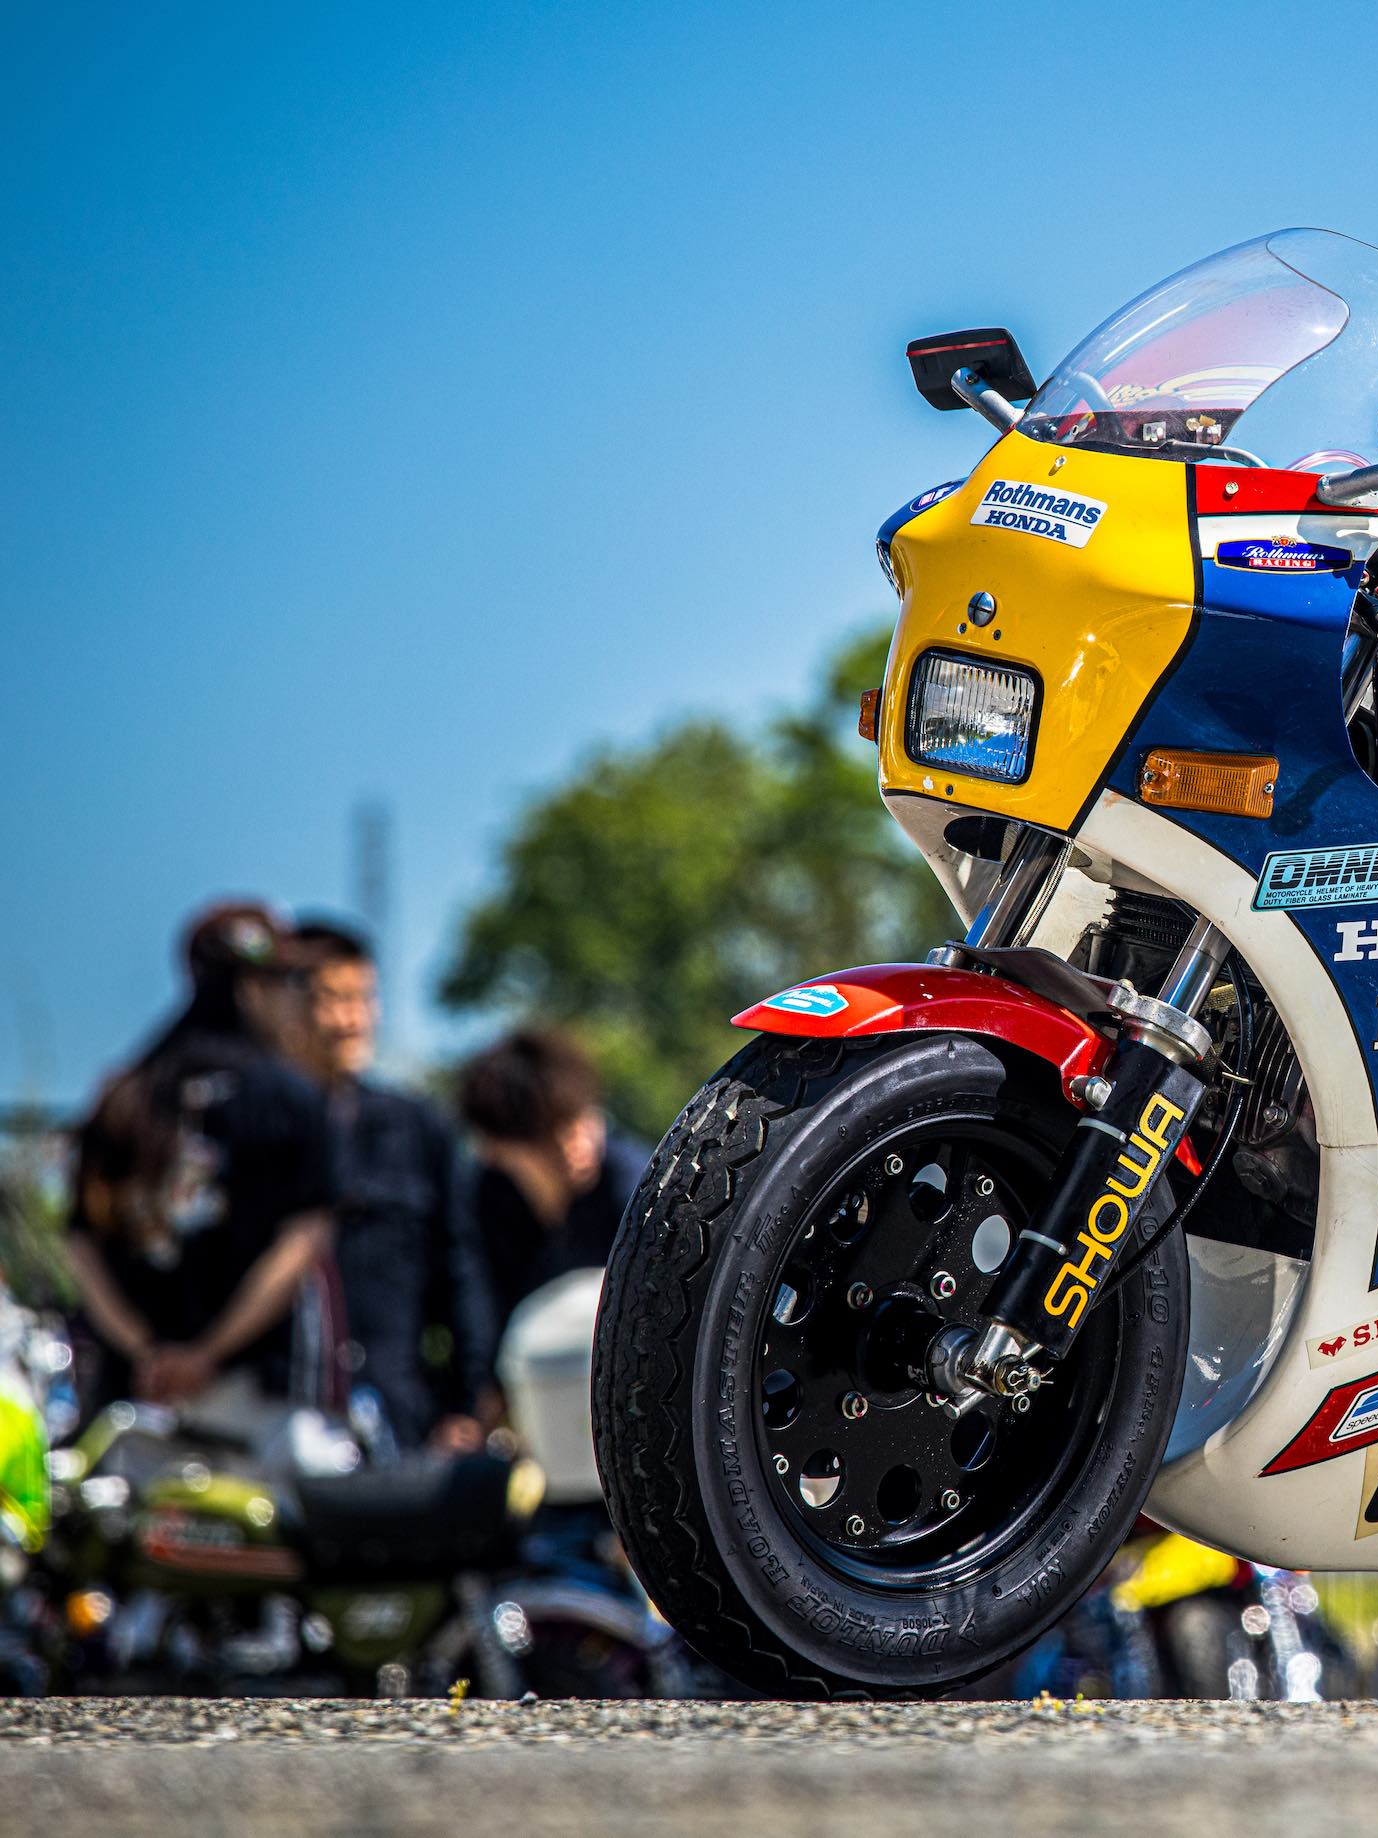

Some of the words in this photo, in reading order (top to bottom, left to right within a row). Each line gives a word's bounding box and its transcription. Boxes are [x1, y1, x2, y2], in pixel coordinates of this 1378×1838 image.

[984, 481, 1101, 524] Rothmans
[985, 510, 1067, 540] HONDA
[1242, 546, 1325, 560] Rothmans
[1253, 559, 1312, 567] RACING
[1265, 889, 1313, 898] MOTORCYCLE
[1316, 886, 1344, 895] HELMET
[1309, 895, 1331, 903] GLASS
[1334, 892, 1368, 901] LAMINATE
[1043, 1092, 1185, 1329] SHOWA
